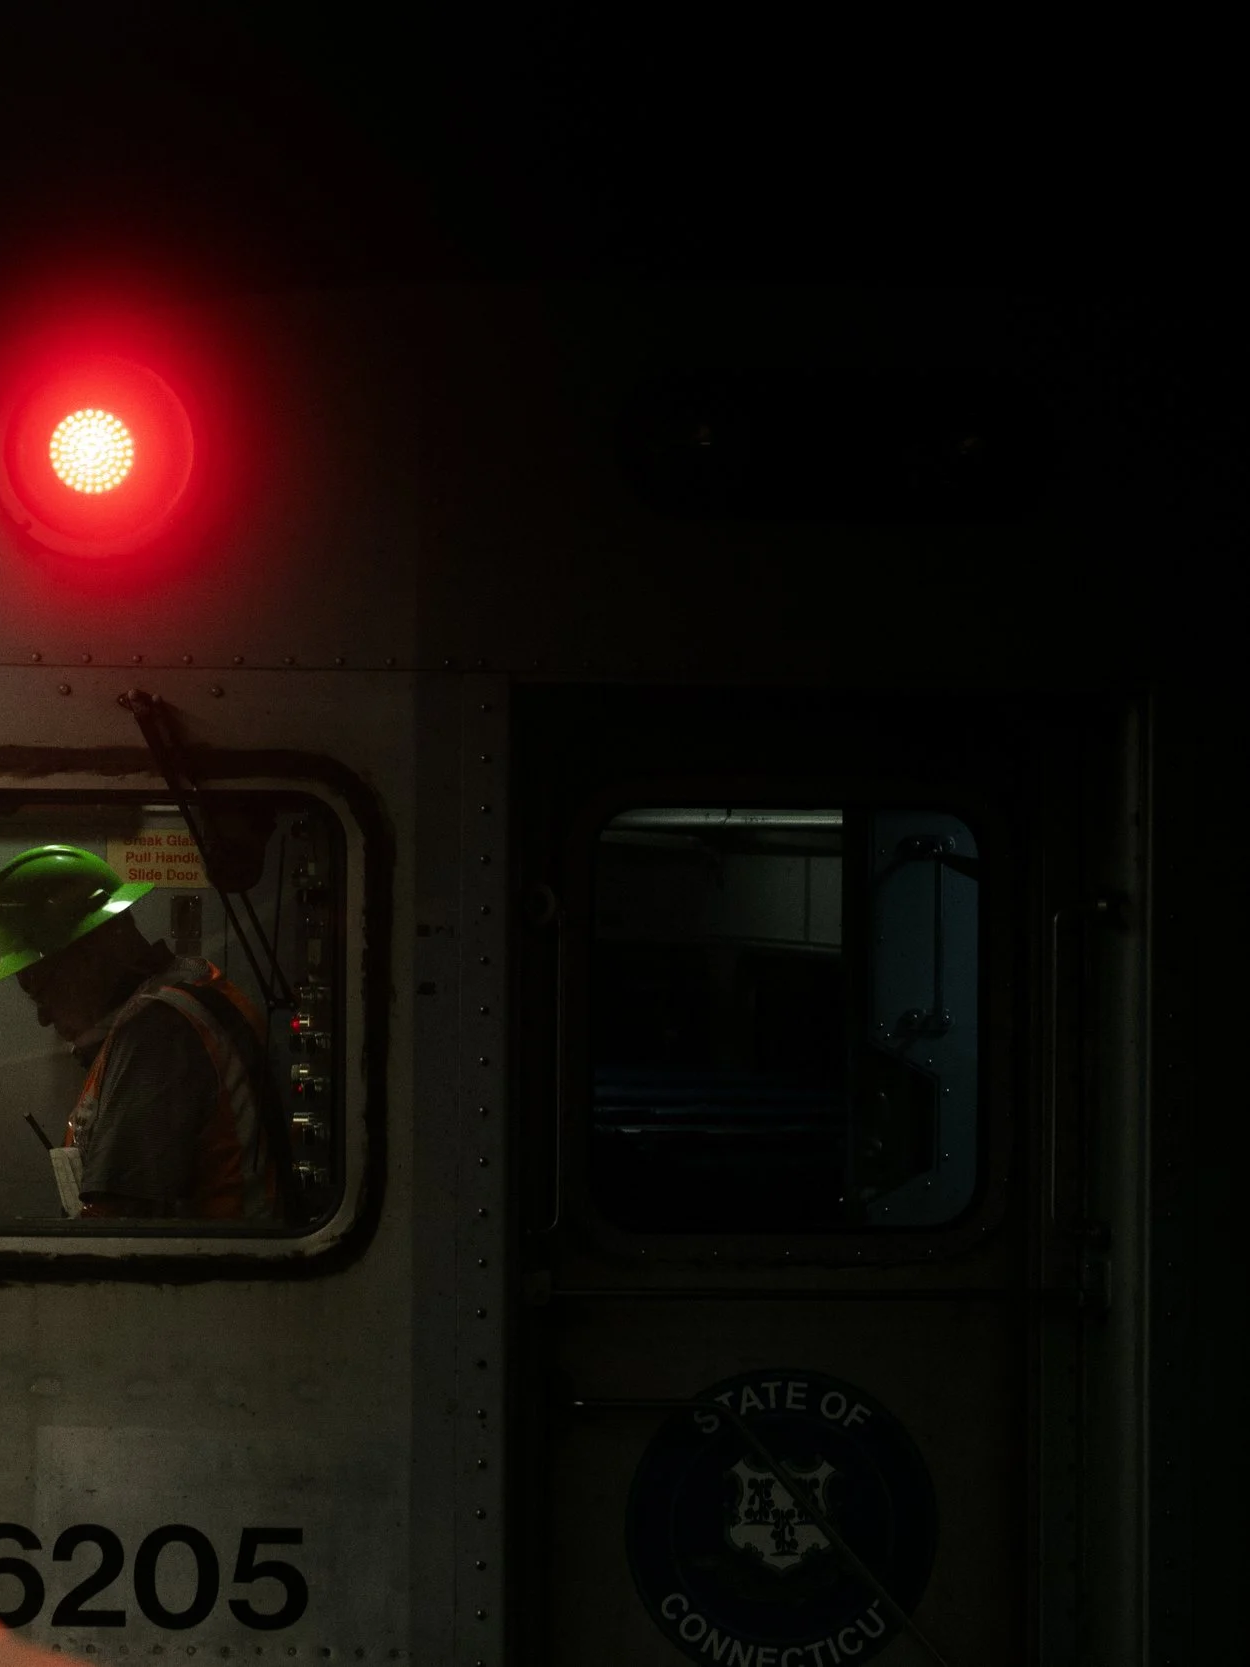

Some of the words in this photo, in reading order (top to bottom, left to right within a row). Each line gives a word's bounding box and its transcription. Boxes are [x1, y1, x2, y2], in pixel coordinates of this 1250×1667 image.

[125, 851, 151, 863] Pull
[128, 868, 162, 881] Slide
[166, 868, 199, 881] Door
[693, 1381, 809, 1434] STATE
[819, 1391, 873, 1429] OF
